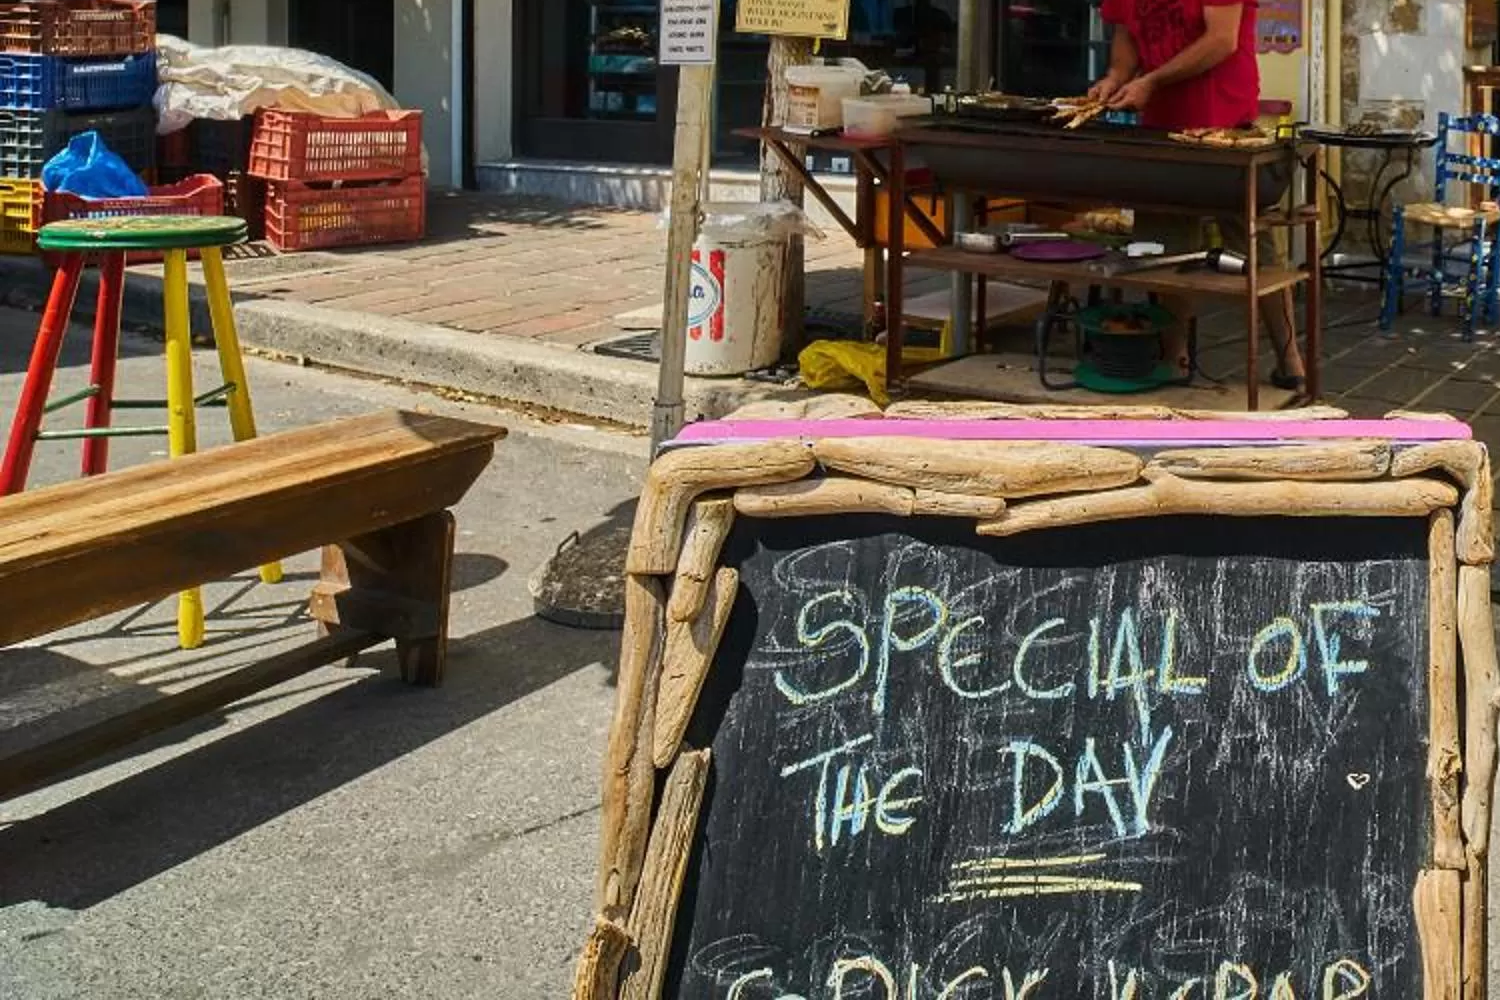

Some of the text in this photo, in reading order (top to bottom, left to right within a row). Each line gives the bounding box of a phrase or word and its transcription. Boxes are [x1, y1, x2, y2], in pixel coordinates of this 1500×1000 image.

[774, 586, 1380, 724] SPECIAL OF
[780, 725, 1173, 852] THE DAY
